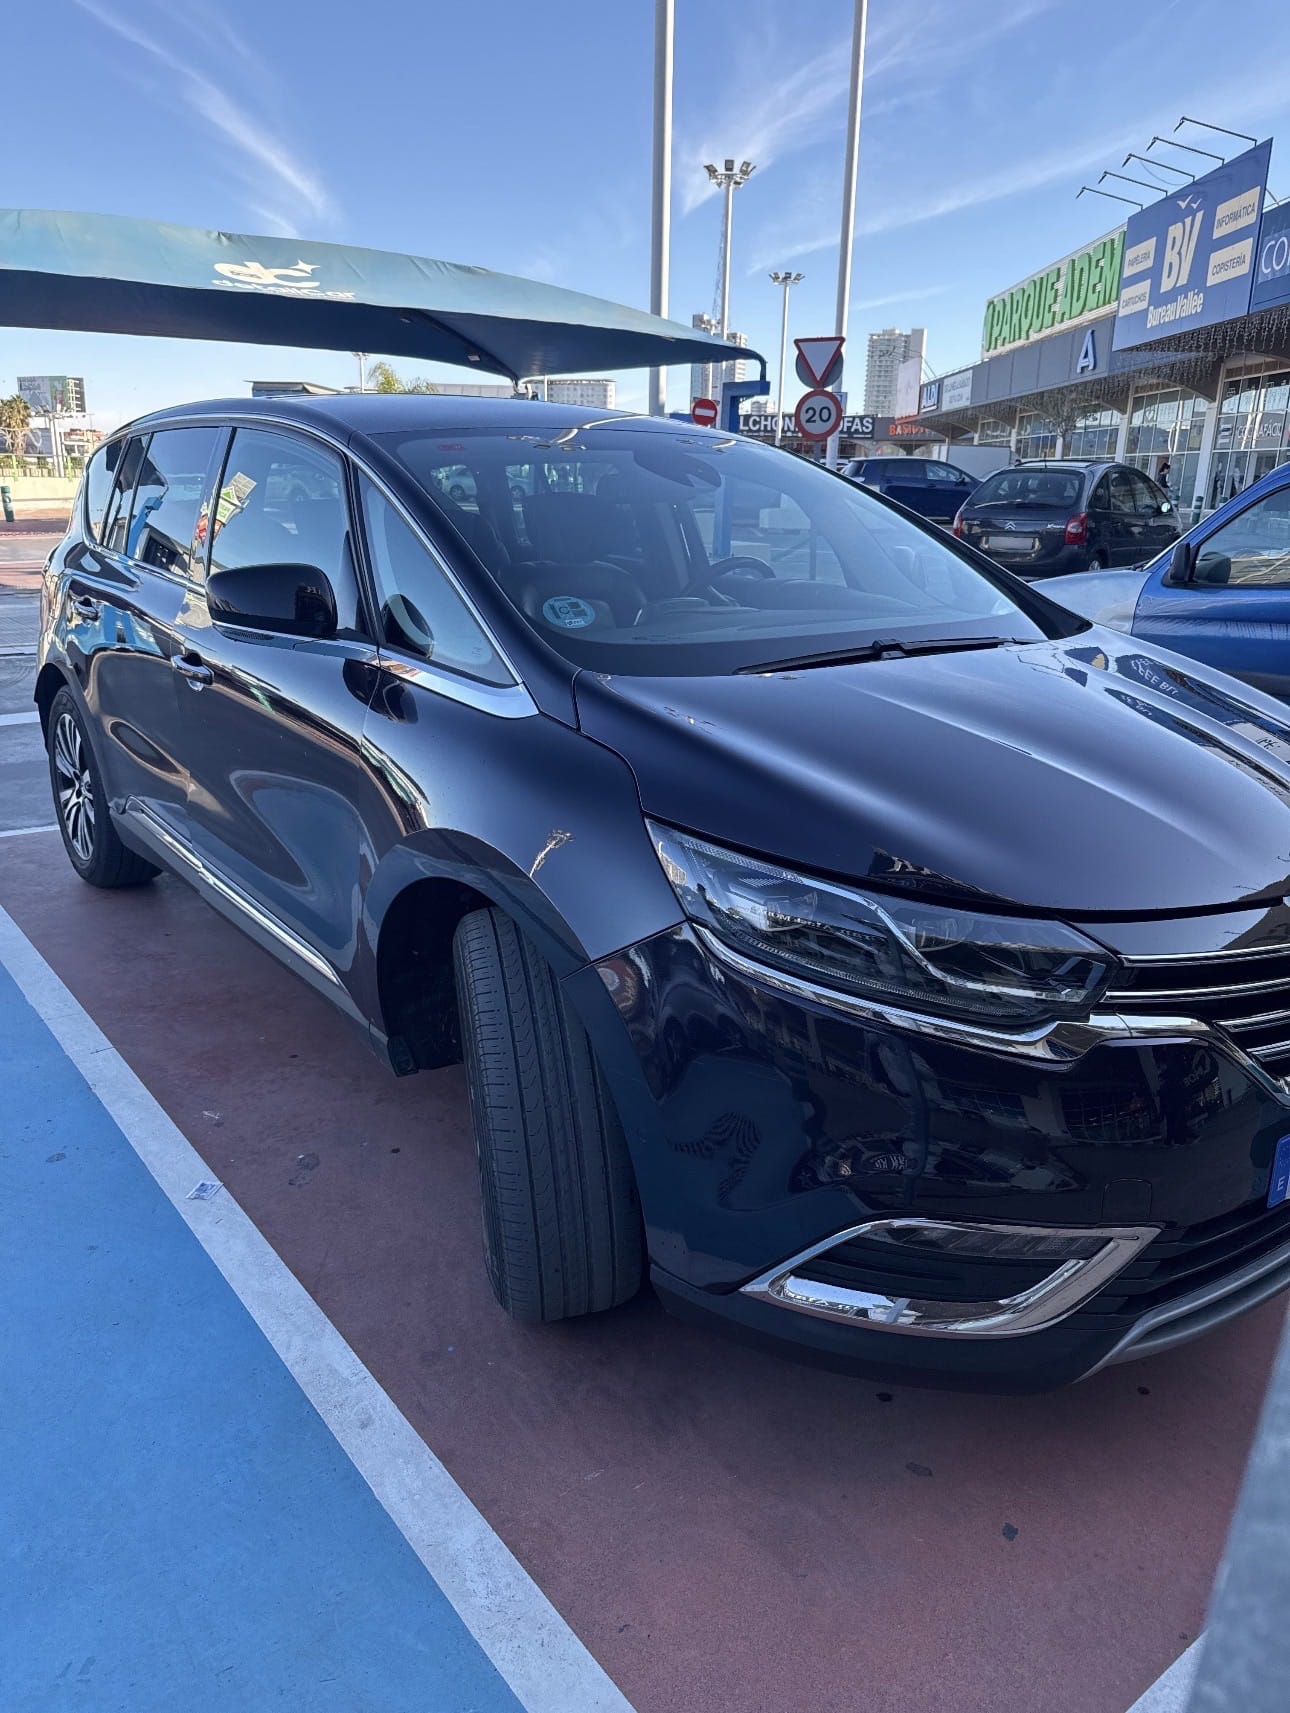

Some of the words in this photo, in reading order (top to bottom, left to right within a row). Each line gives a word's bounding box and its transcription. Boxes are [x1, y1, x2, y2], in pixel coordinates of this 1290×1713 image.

[1160, 210, 1204, 293] BV
[1262, 236, 1290, 274] CO
[991, 267, 1061, 350] PARQUE
[1077, 329, 1096, 374] A
[804, 406, 832, 424] 20
[1277, 1176, 1286, 1191] E
